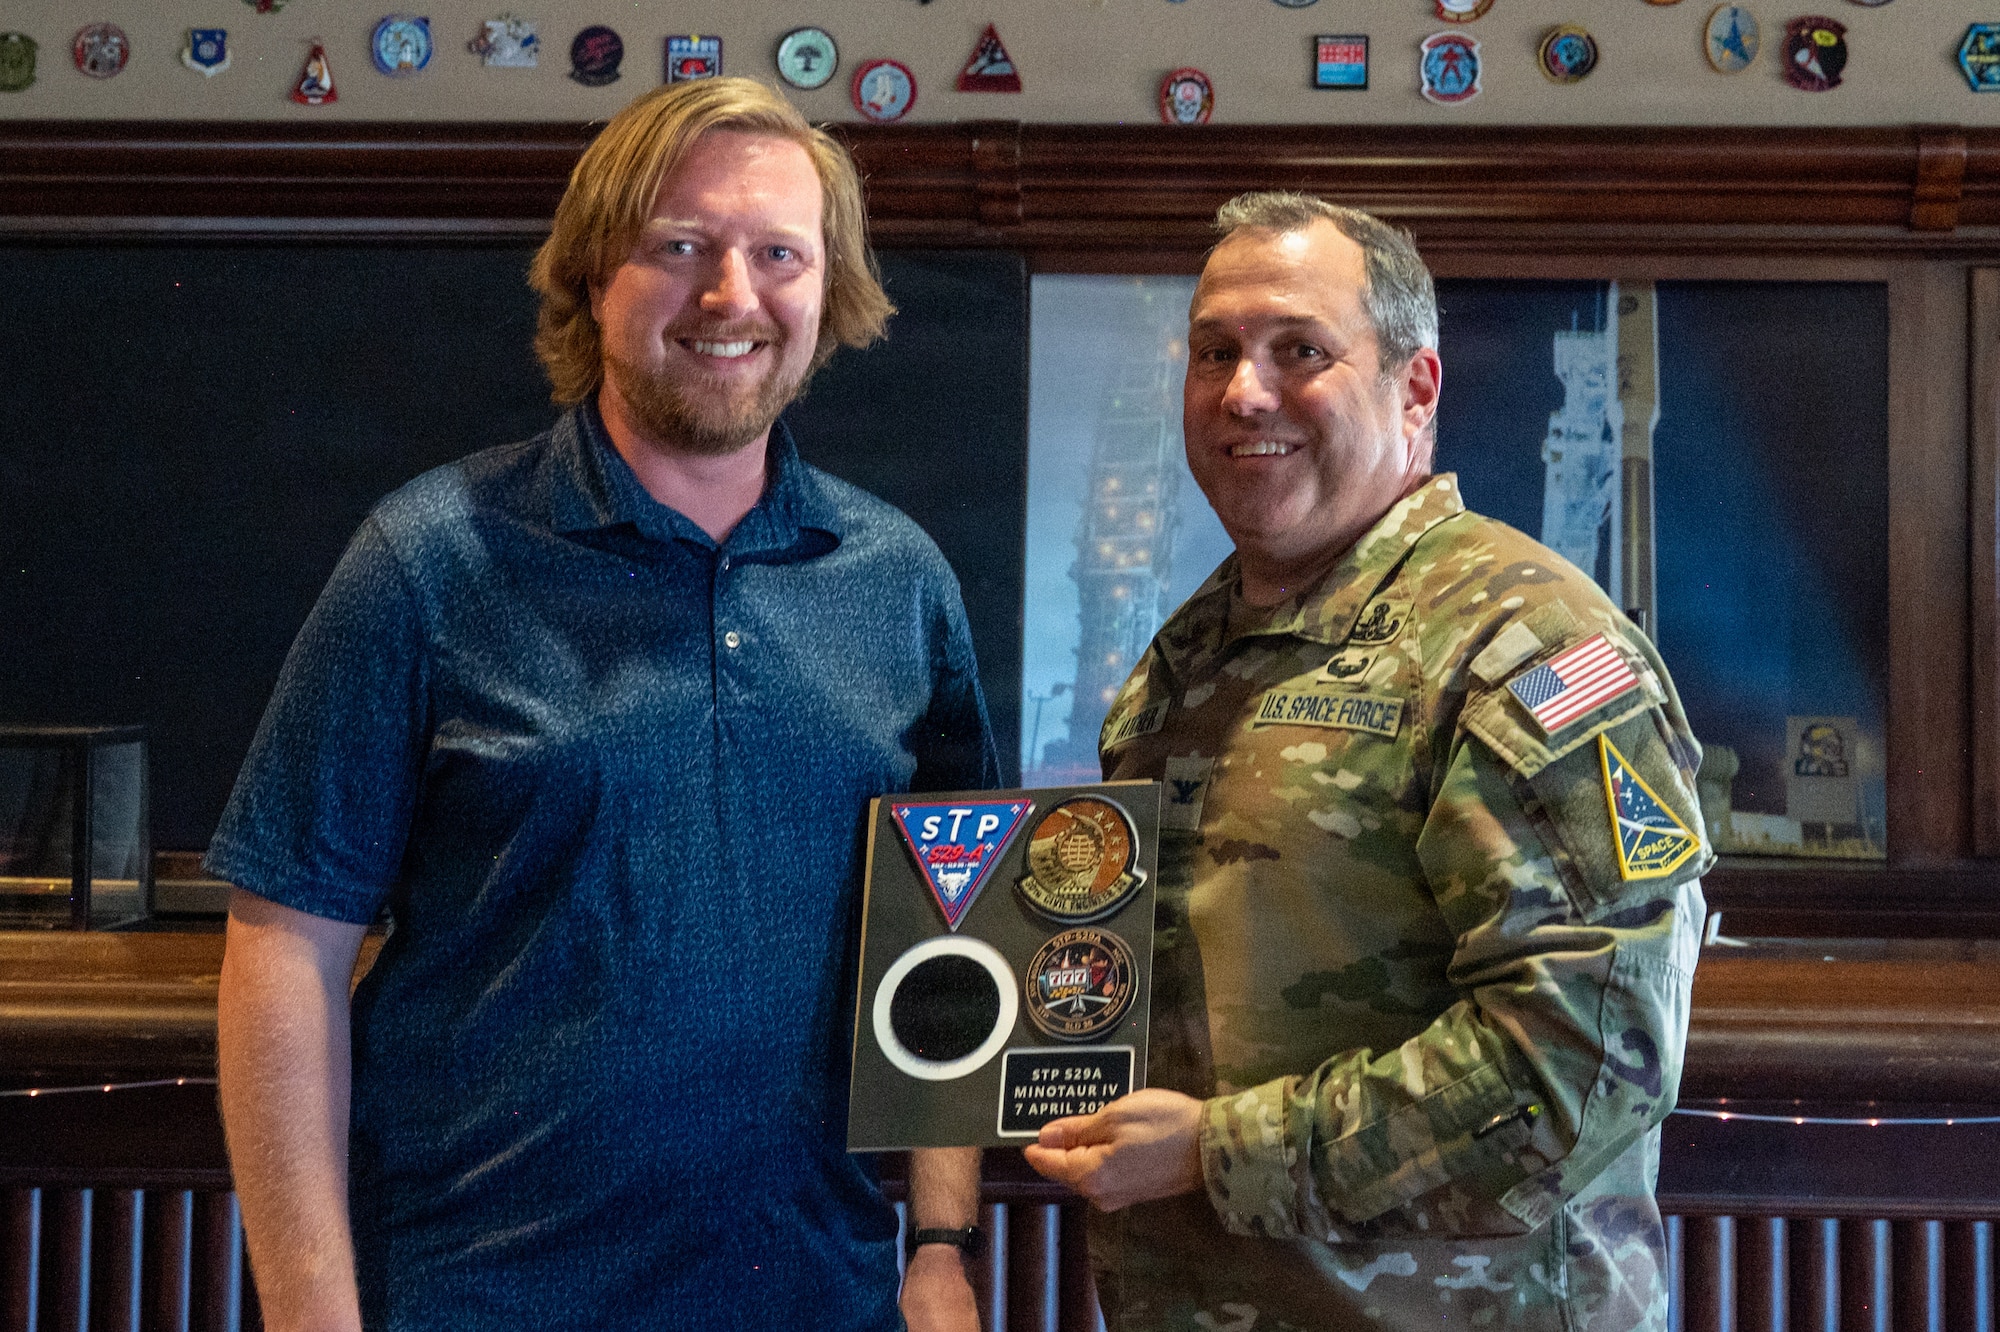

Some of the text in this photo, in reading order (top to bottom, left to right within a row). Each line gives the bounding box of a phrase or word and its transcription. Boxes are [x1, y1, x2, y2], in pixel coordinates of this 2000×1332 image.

[1260, 693, 1398, 732] U.S. SPACE FORCE
[921, 809, 999, 842] STP
[928, 844, 985, 862] S29-A
[1637, 835, 1675, 860] SPACE
[1031, 1067, 1102, 1081] STP S29A
[1014, 1083, 1118, 1099] MINOTAUR IV
[1015, 1101, 1106, 1116] 7 APRIL 202
